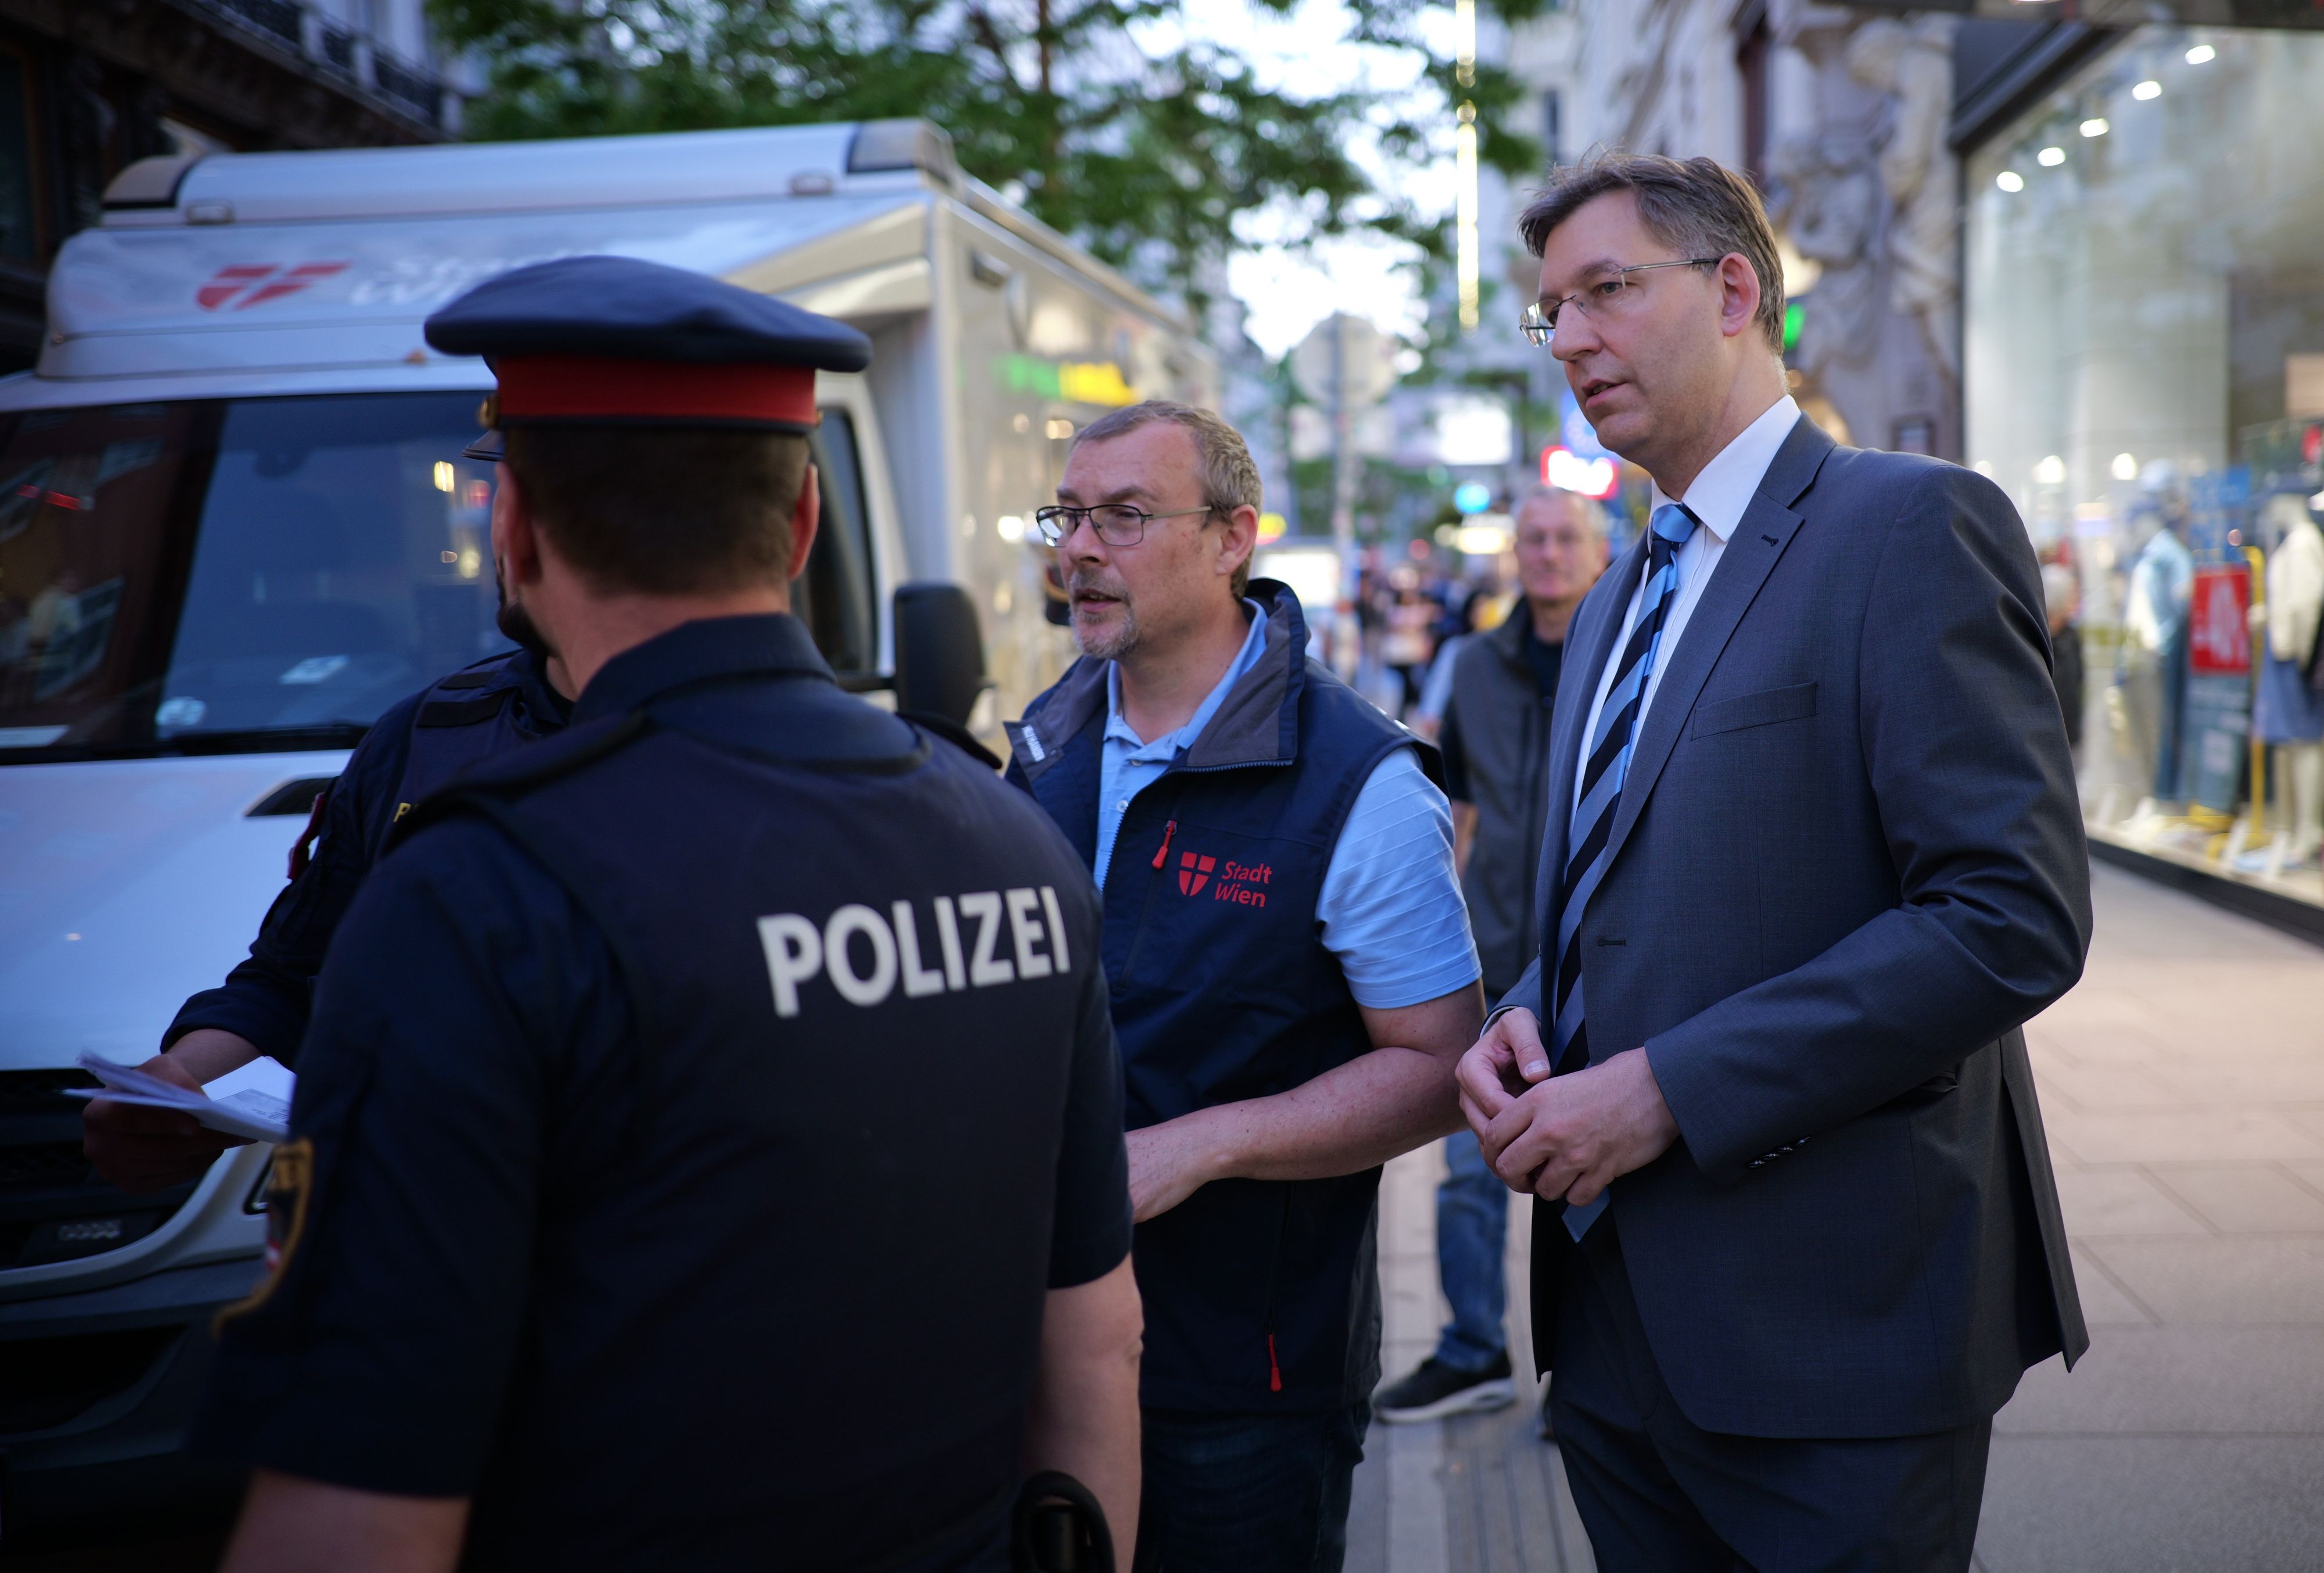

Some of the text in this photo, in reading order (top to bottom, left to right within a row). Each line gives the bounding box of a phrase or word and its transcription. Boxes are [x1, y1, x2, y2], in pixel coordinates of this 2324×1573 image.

[1221, 861, 1272, 884] Stadt
[1214, 882, 1266, 908] Wien
[756, 885, 1071, 1019] POLIZEI
